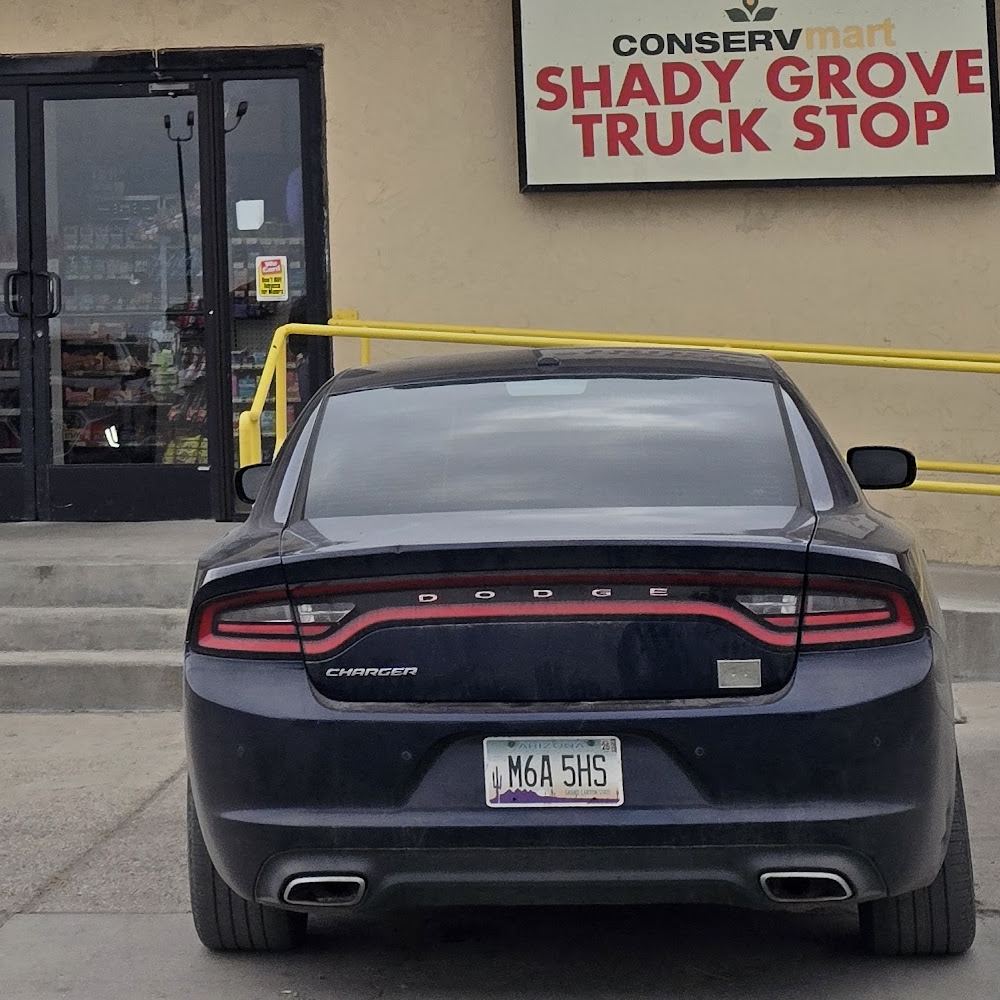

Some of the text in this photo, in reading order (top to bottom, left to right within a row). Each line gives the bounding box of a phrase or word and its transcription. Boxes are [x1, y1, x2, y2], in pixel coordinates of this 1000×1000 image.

[536, 49, 985, 111] SHADY GROVE
[572, 101, 950, 158] TRUCK STOP
[418, 587, 668, 603] DODGE
[325, 666, 418, 677] CHARGER
[519, 741, 584, 750] ARIZONA
[508, 754, 607, 788] M6A 5HS
